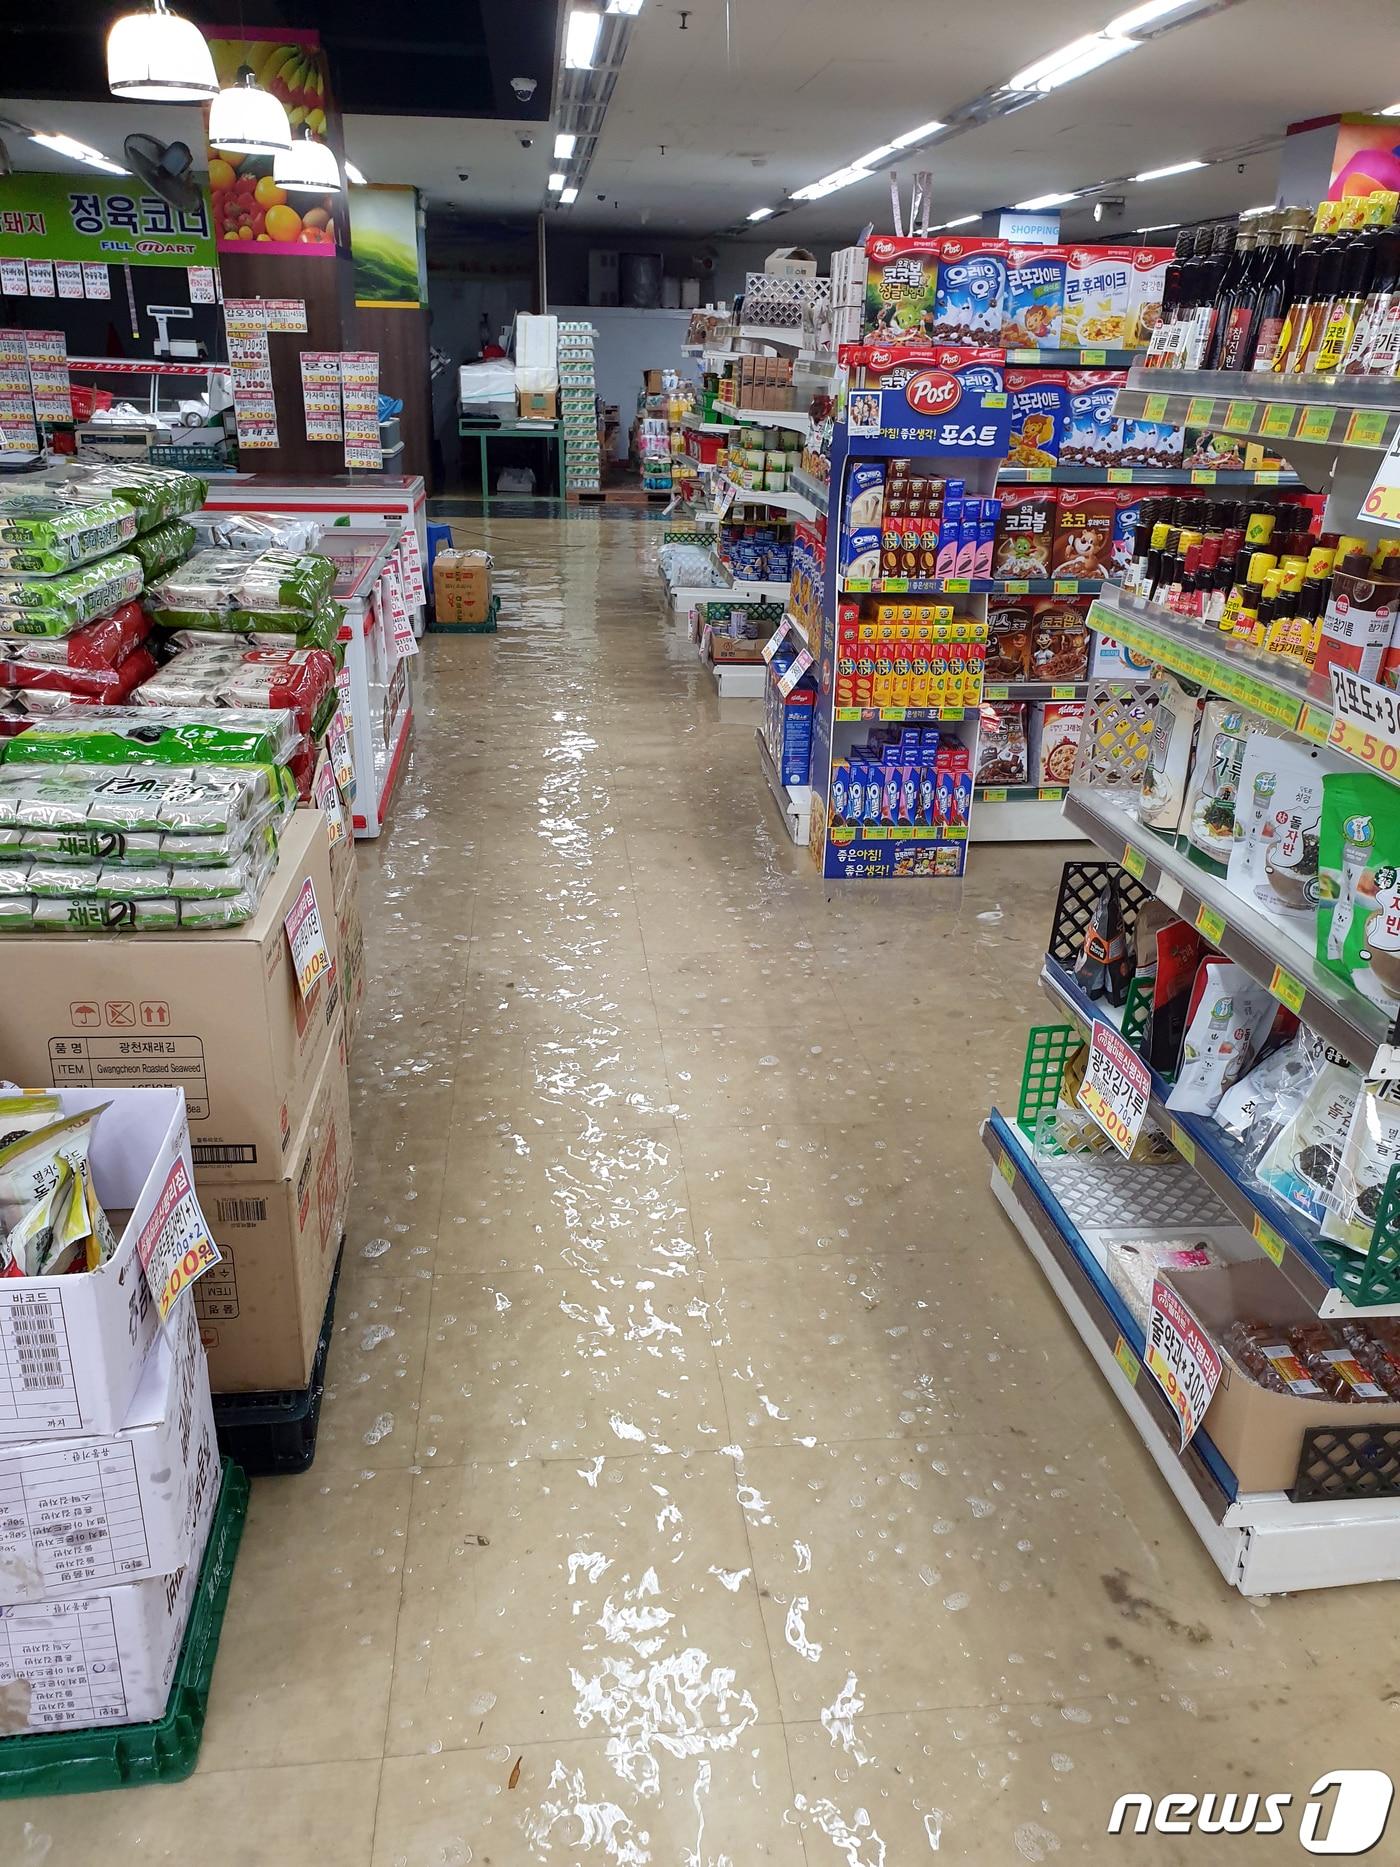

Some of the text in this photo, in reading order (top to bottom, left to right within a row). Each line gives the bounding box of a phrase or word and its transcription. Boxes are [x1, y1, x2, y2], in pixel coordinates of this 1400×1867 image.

[0, 211, 46, 235] 돼지
[69, 194, 210, 238] 정육코너
[1011, 225, 1059, 236] SHOPPING
[101, 241, 133, 251] FILL
[947, 265, 996, 285] 오레오
[872, 351, 889, 362] Post
[942, 352, 960, 365] Post
[914, 380, 956, 405] Post
[901, 425, 998, 446] 좋은생각! 포스트
[1005, 511, 1047, 533] 코코볼
[1060, 511, 1086, 528] 초코
[1334, 617, 1354, 637] 참기름
[1333, 670, 1400, 735] 건포도3
[57, 832, 126, 860] 재래김
[837, 849, 882, 861] 좋은아침!
[845, 865, 889, 876] 좋은생각!
[67, 901, 137, 928] 재래김
[119, 1041, 176, 1054] 광천재래김
[58, 1063, 85, 1074] ITEM
[97, 1063, 201, 1075] Gwangcheon Roasted Seaweed
[1092, 1049, 1145, 1117] 광천김가루
[1080, 1080, 1133, 1151] 2,500원
[12, 1291, 48, 1304] 바코드
[208, 1287, 232, 1296] ITEM
